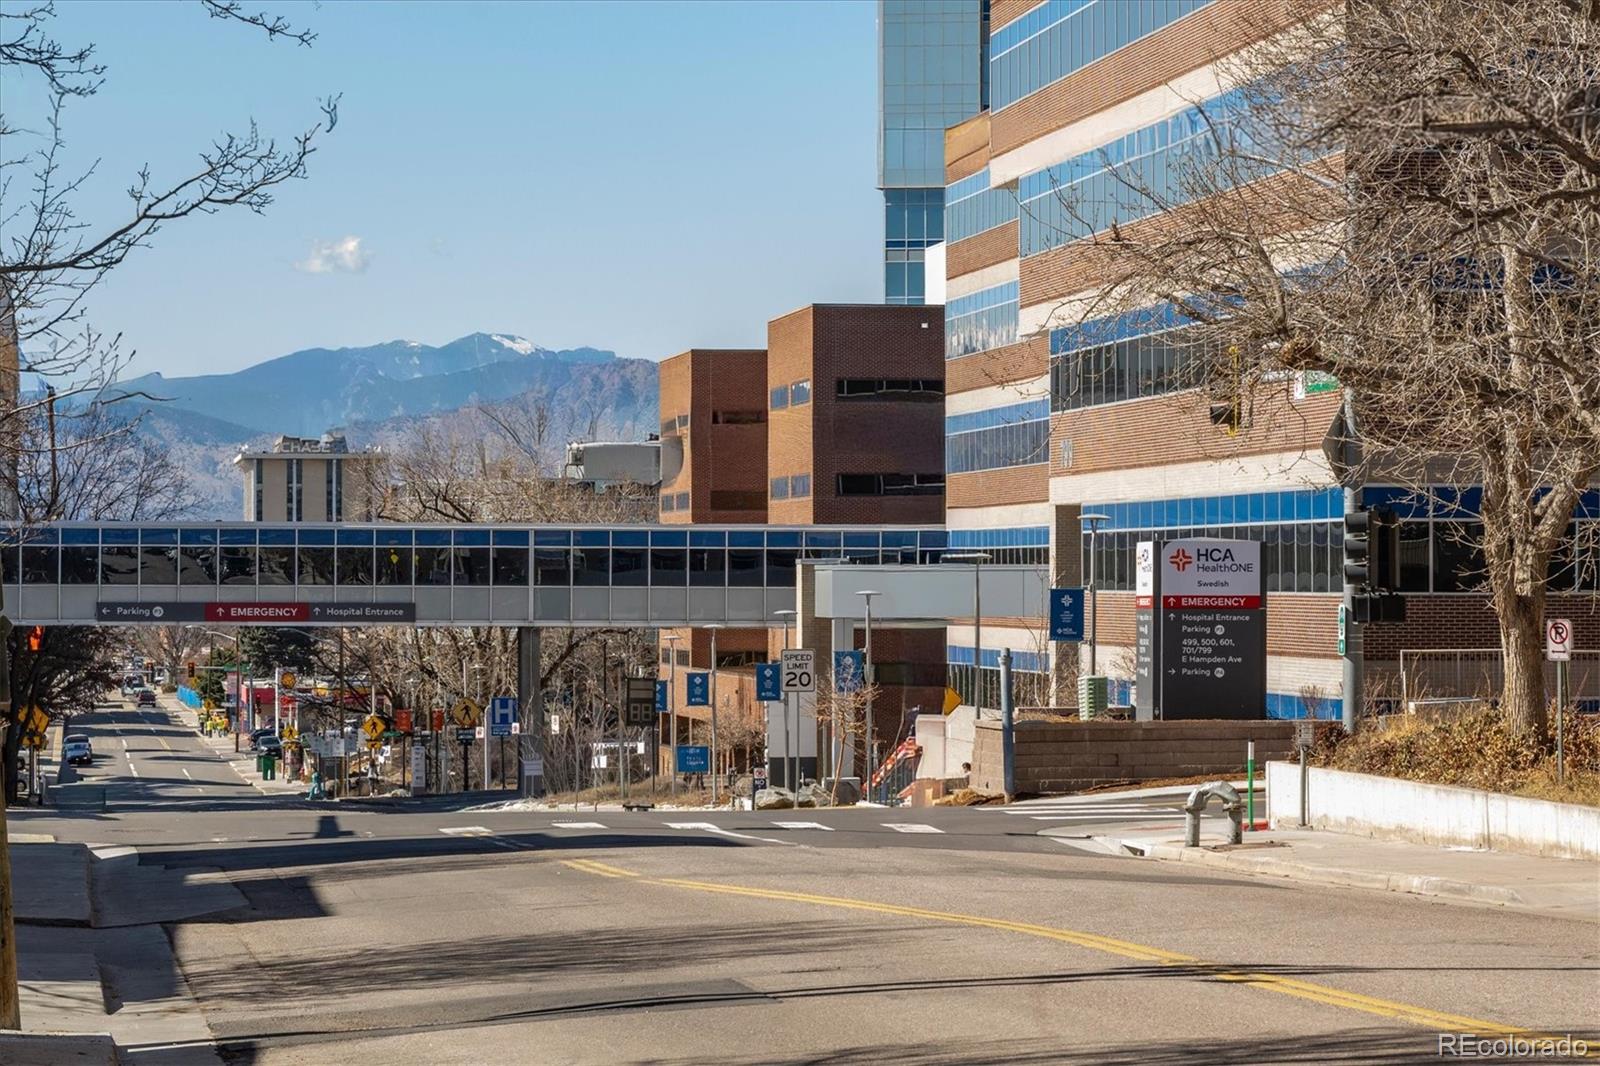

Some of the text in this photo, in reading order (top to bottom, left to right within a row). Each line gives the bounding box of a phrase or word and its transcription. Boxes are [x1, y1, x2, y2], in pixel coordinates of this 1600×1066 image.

[1196, 548, 1235, 562] HCA
[1196, 563, 1254, 573] HealthONE
[1197, 580, 1230, 588] Swedish
[1181, 597, 1247, 606] EMERGENCY
[116, 607, 150, 617] Parking
[230, 607, 298, 616] EMERGENCY
[326, 607, 404, 617] Hospital Entrance
[1181, 613, 1250, 622] Hospital Entrance
[1181, 625, 1211, 634] Parking
[1219, 639, 1235, 647] 601,
[1189, 656, 1227, 664] Hampden
[1181, 668, 1211, 677] Parking
[785, 671, 812, 687] 20
[494, 699, 514, 724] H
